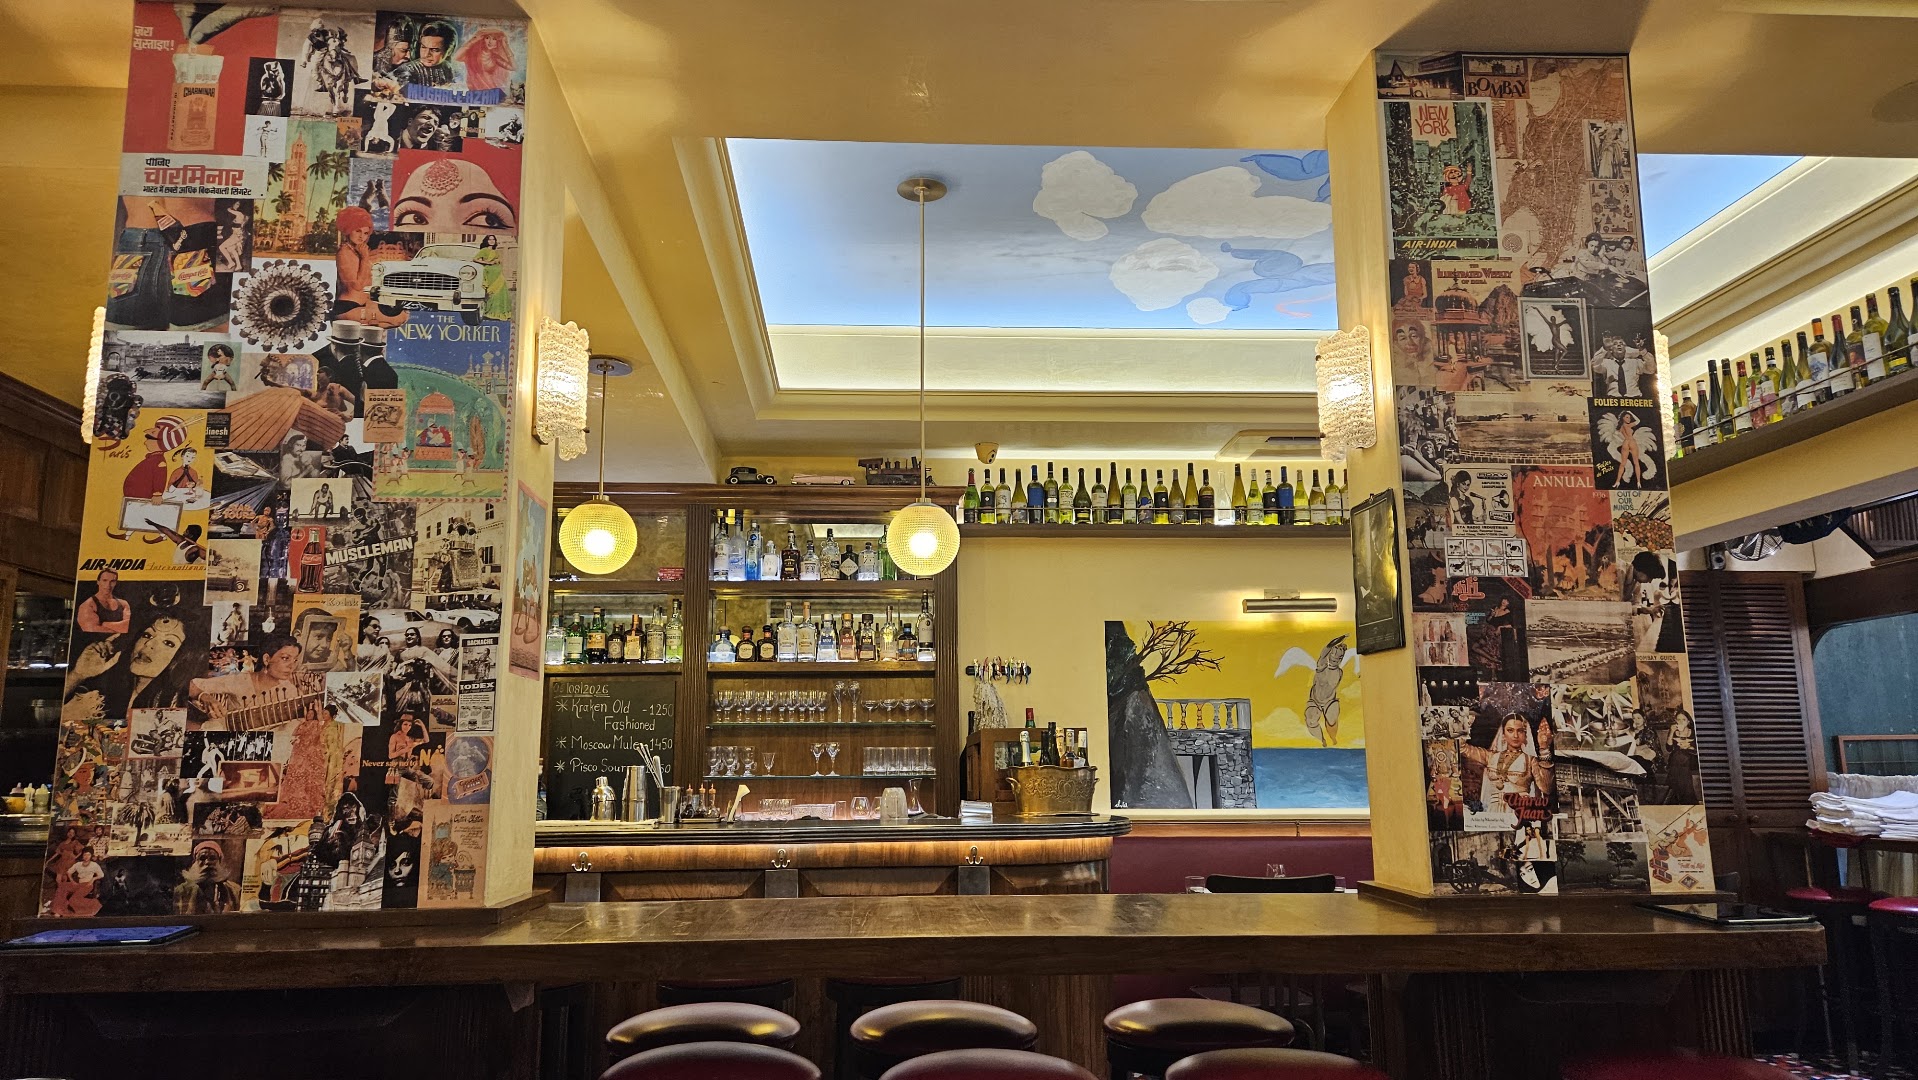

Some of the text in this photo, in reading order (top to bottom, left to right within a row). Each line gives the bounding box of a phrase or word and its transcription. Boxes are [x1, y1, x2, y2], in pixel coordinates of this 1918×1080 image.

[183, 87, 216, 98] CHARMINAR
[407, 83, 501, 105] MUGHAL-E-AZAM
[1466, 77, 1528, 98] BOMBAY
[1418, 103, 1448, 121] NEW
[1415, 119, 1451, 137] YORK
[144, 165, 245, 187] चारमिनार
[1402, 240, 1458, 249] AIR-INDIA
[437, 315, 456, 324] THE
[394, 323, 502, 342] NEW YORKER
[1594, 398, 1653, 408] FOLIES BERGERE
[1533, 475, 1594, 488] ANNUAL
[326, 537, 414, 566] MUSCLEMAN
[79, 559, 147, 570] AIR-INDIA
[460, 681, 495, 690] IODEX
[572, 698, 607, 721] Kraken
[613, 699, 631, 714] Old
[604, 716, 656, 731] Fashioned
[571, 735, 611, 750] Moscow
[569, 757, 598, 772] Pisco
[1512, 806, 1550, 829] Jaan
